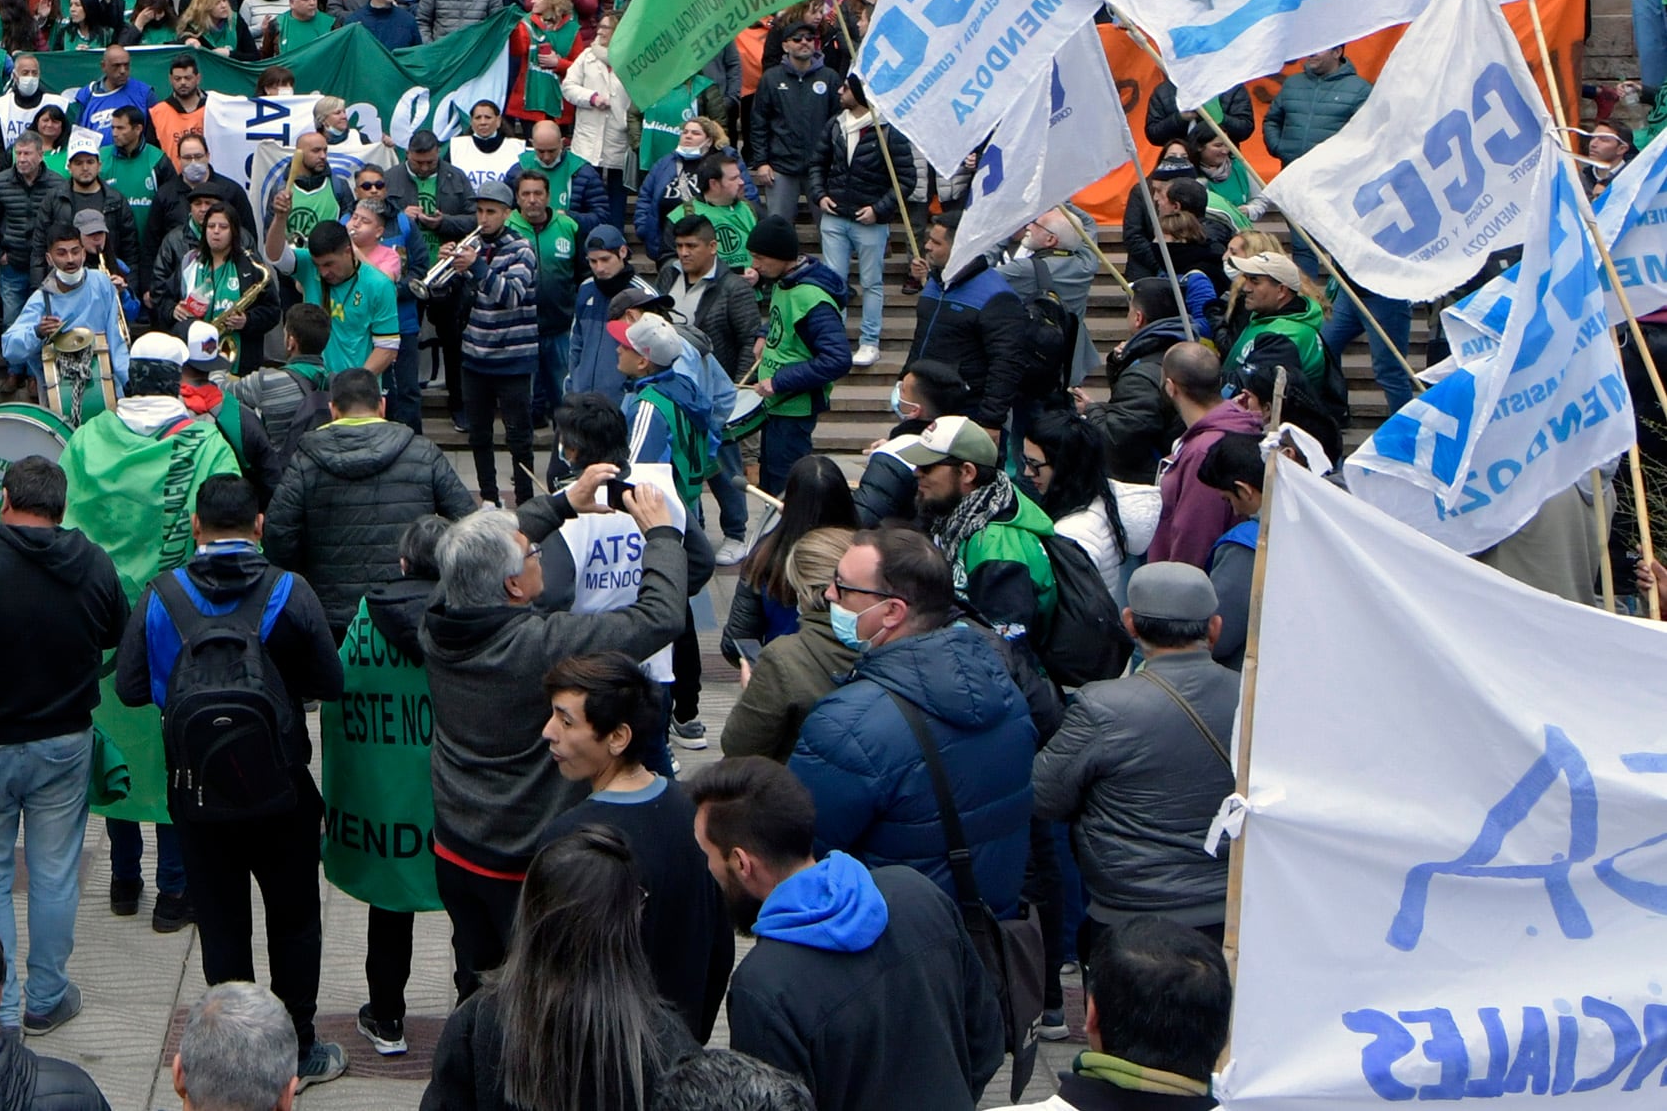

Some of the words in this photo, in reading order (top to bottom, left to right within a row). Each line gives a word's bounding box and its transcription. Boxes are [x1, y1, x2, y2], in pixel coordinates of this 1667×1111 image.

[469, 170, 506, 185] ATSA
[163, 428, 206, 514] MENDOZA
[342, 692, 396, 744] ESTE
